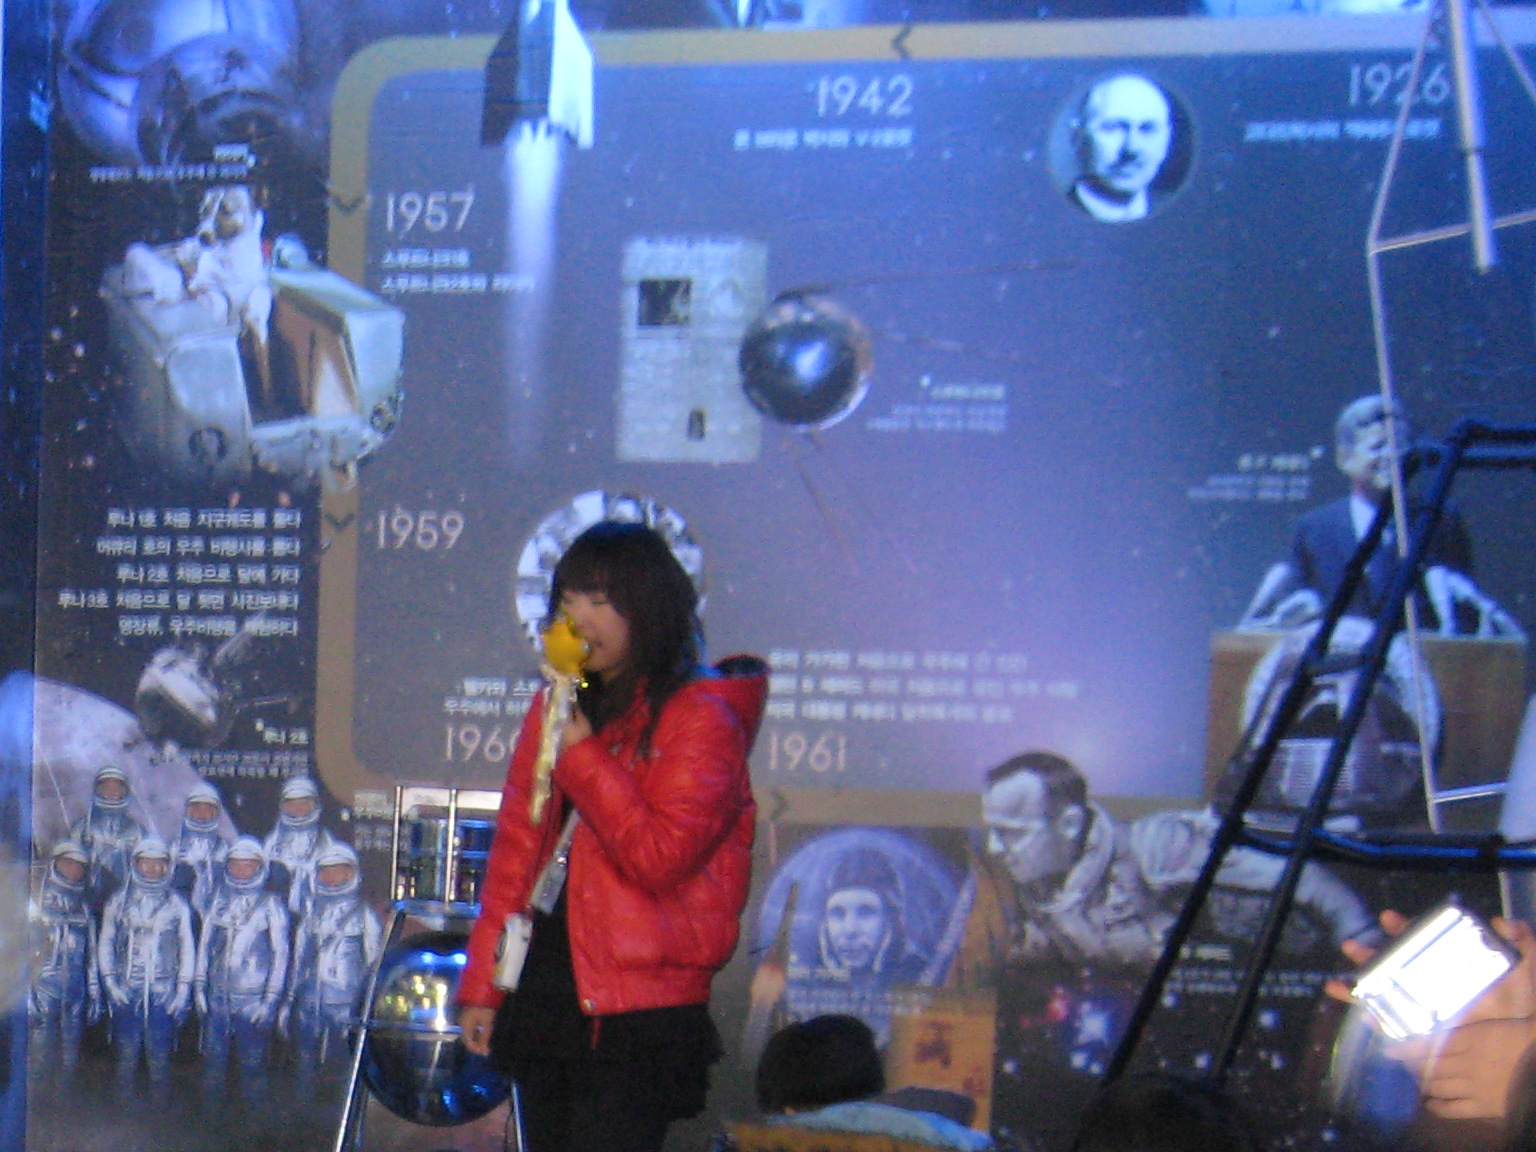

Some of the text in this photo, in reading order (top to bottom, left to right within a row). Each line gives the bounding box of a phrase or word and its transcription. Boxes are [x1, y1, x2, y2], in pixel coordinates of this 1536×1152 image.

[818, 75, 912, 117] 1942
[1350, 62, 1450, 106] 1926
[386, 192, 475, 232] 1957
[177, 535, 204, 556] 우주
[377, 511, 464, 549] 1959
[176, 562, 231, 583] 처음으로
[116, 588, 170, 609] 처음으로
[768, 731, 847, 772] 1961
